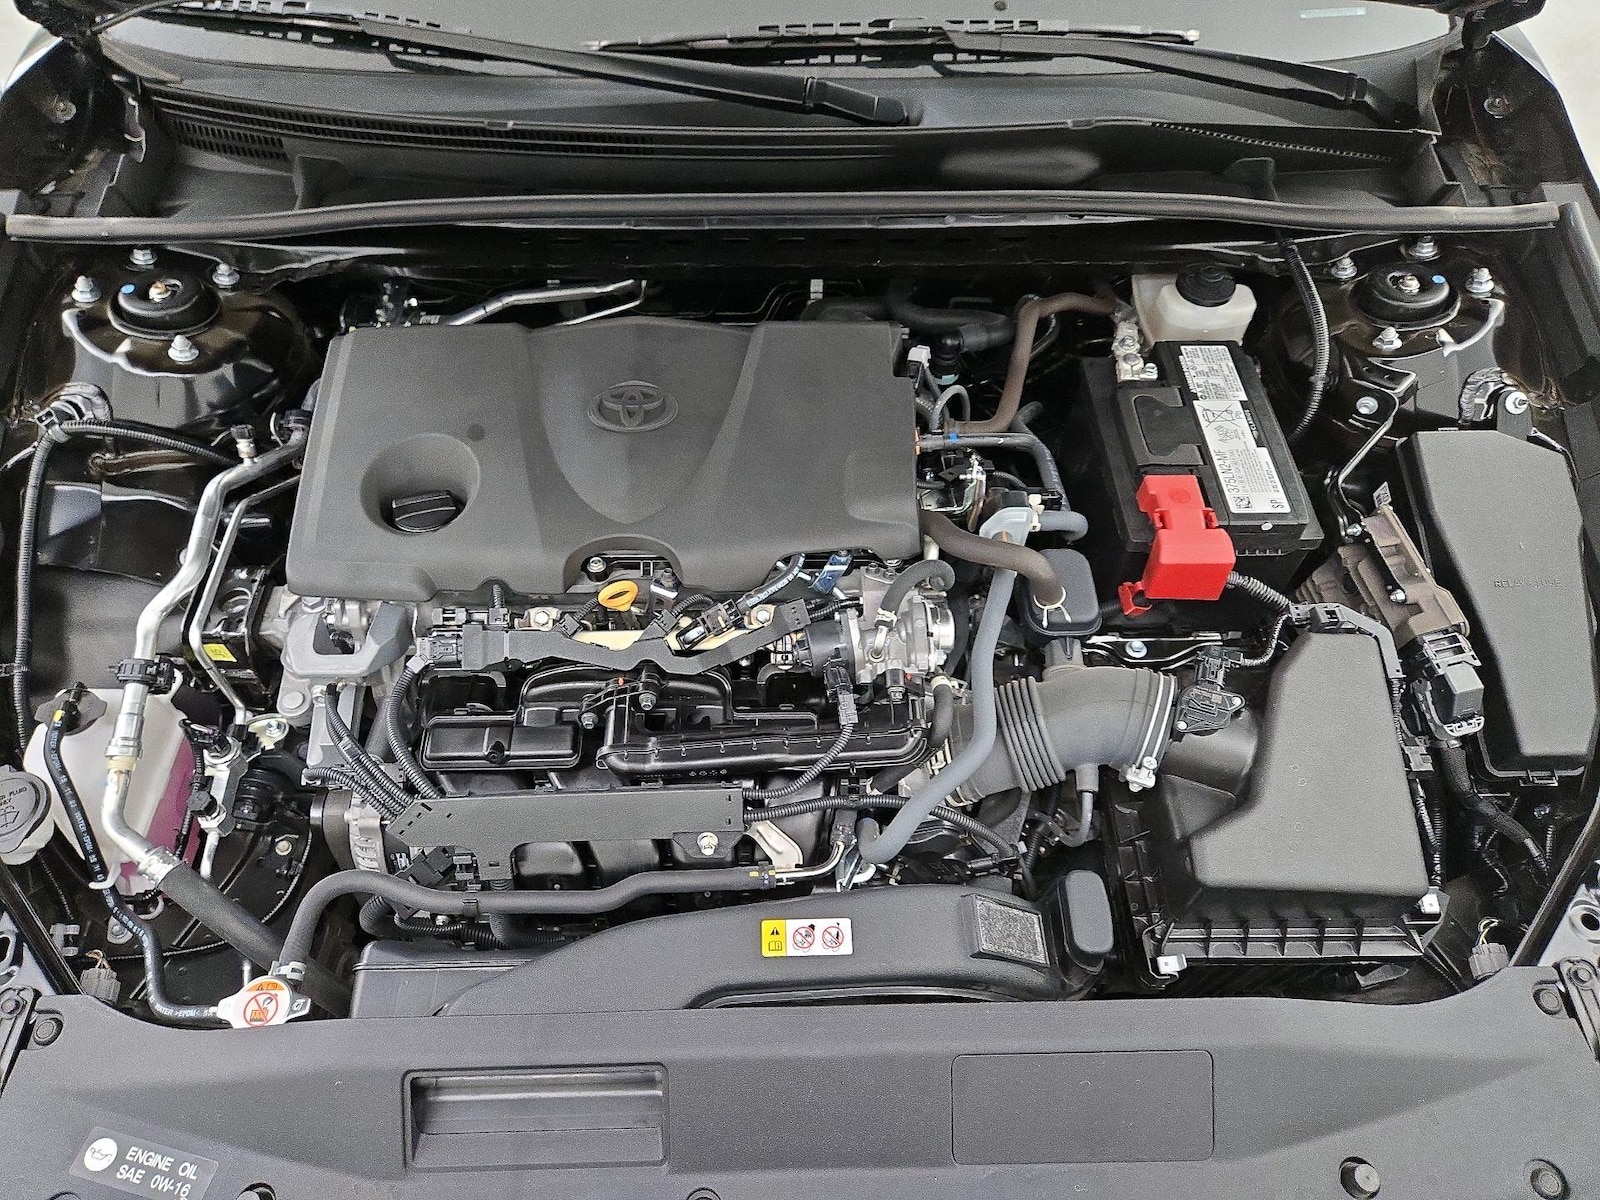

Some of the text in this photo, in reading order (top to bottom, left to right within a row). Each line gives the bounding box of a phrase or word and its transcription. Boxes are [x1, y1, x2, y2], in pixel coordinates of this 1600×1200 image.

[1214, 449, 1239, 493] 375LN2-MF
[1270, 499, 1284, 508] SP
[74, 811, 87, 832] WATER
[126, 1146, 198, 1180] ENGINE OIL
[116, 1164, 191, 1196] SAE 0W-16
